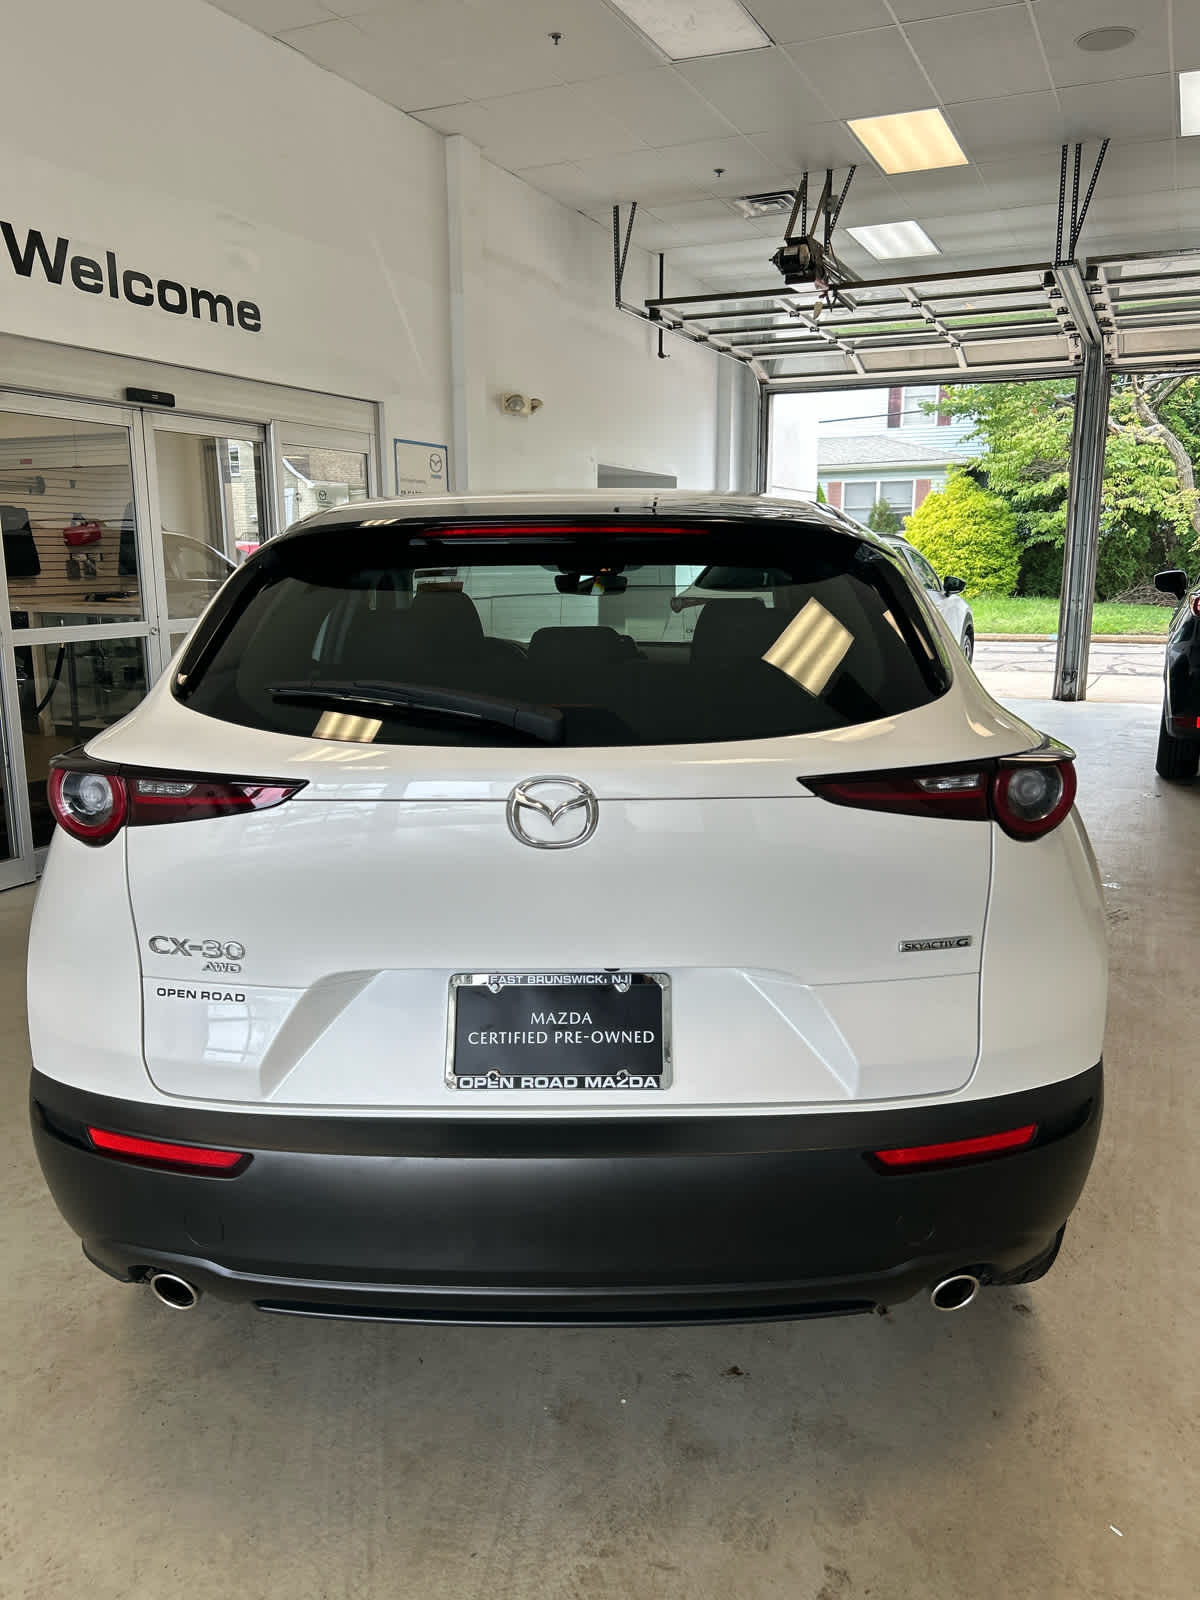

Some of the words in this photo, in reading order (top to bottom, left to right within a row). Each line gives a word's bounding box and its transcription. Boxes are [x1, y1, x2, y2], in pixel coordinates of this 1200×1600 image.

[0, 220, 262, 333] Welcome
[148, 935, 246, 961] CX-30
[202, 961, 242, 974] AWD
[156, 987, 197, 1000] OPEN
[200, 991, 246, 1003] ROAD
[530, 1012, 593, 1025] MAZDA
[467, 1031, 548, 1045] CERTIFIED
[554, 1031, 655, 1044] PRE-OWNED
[459, 1077, 514, 1089] OPEN
[520, 1077, 578, 1088] ROAD
[584, 1076, 658, 1088] MAZDA
